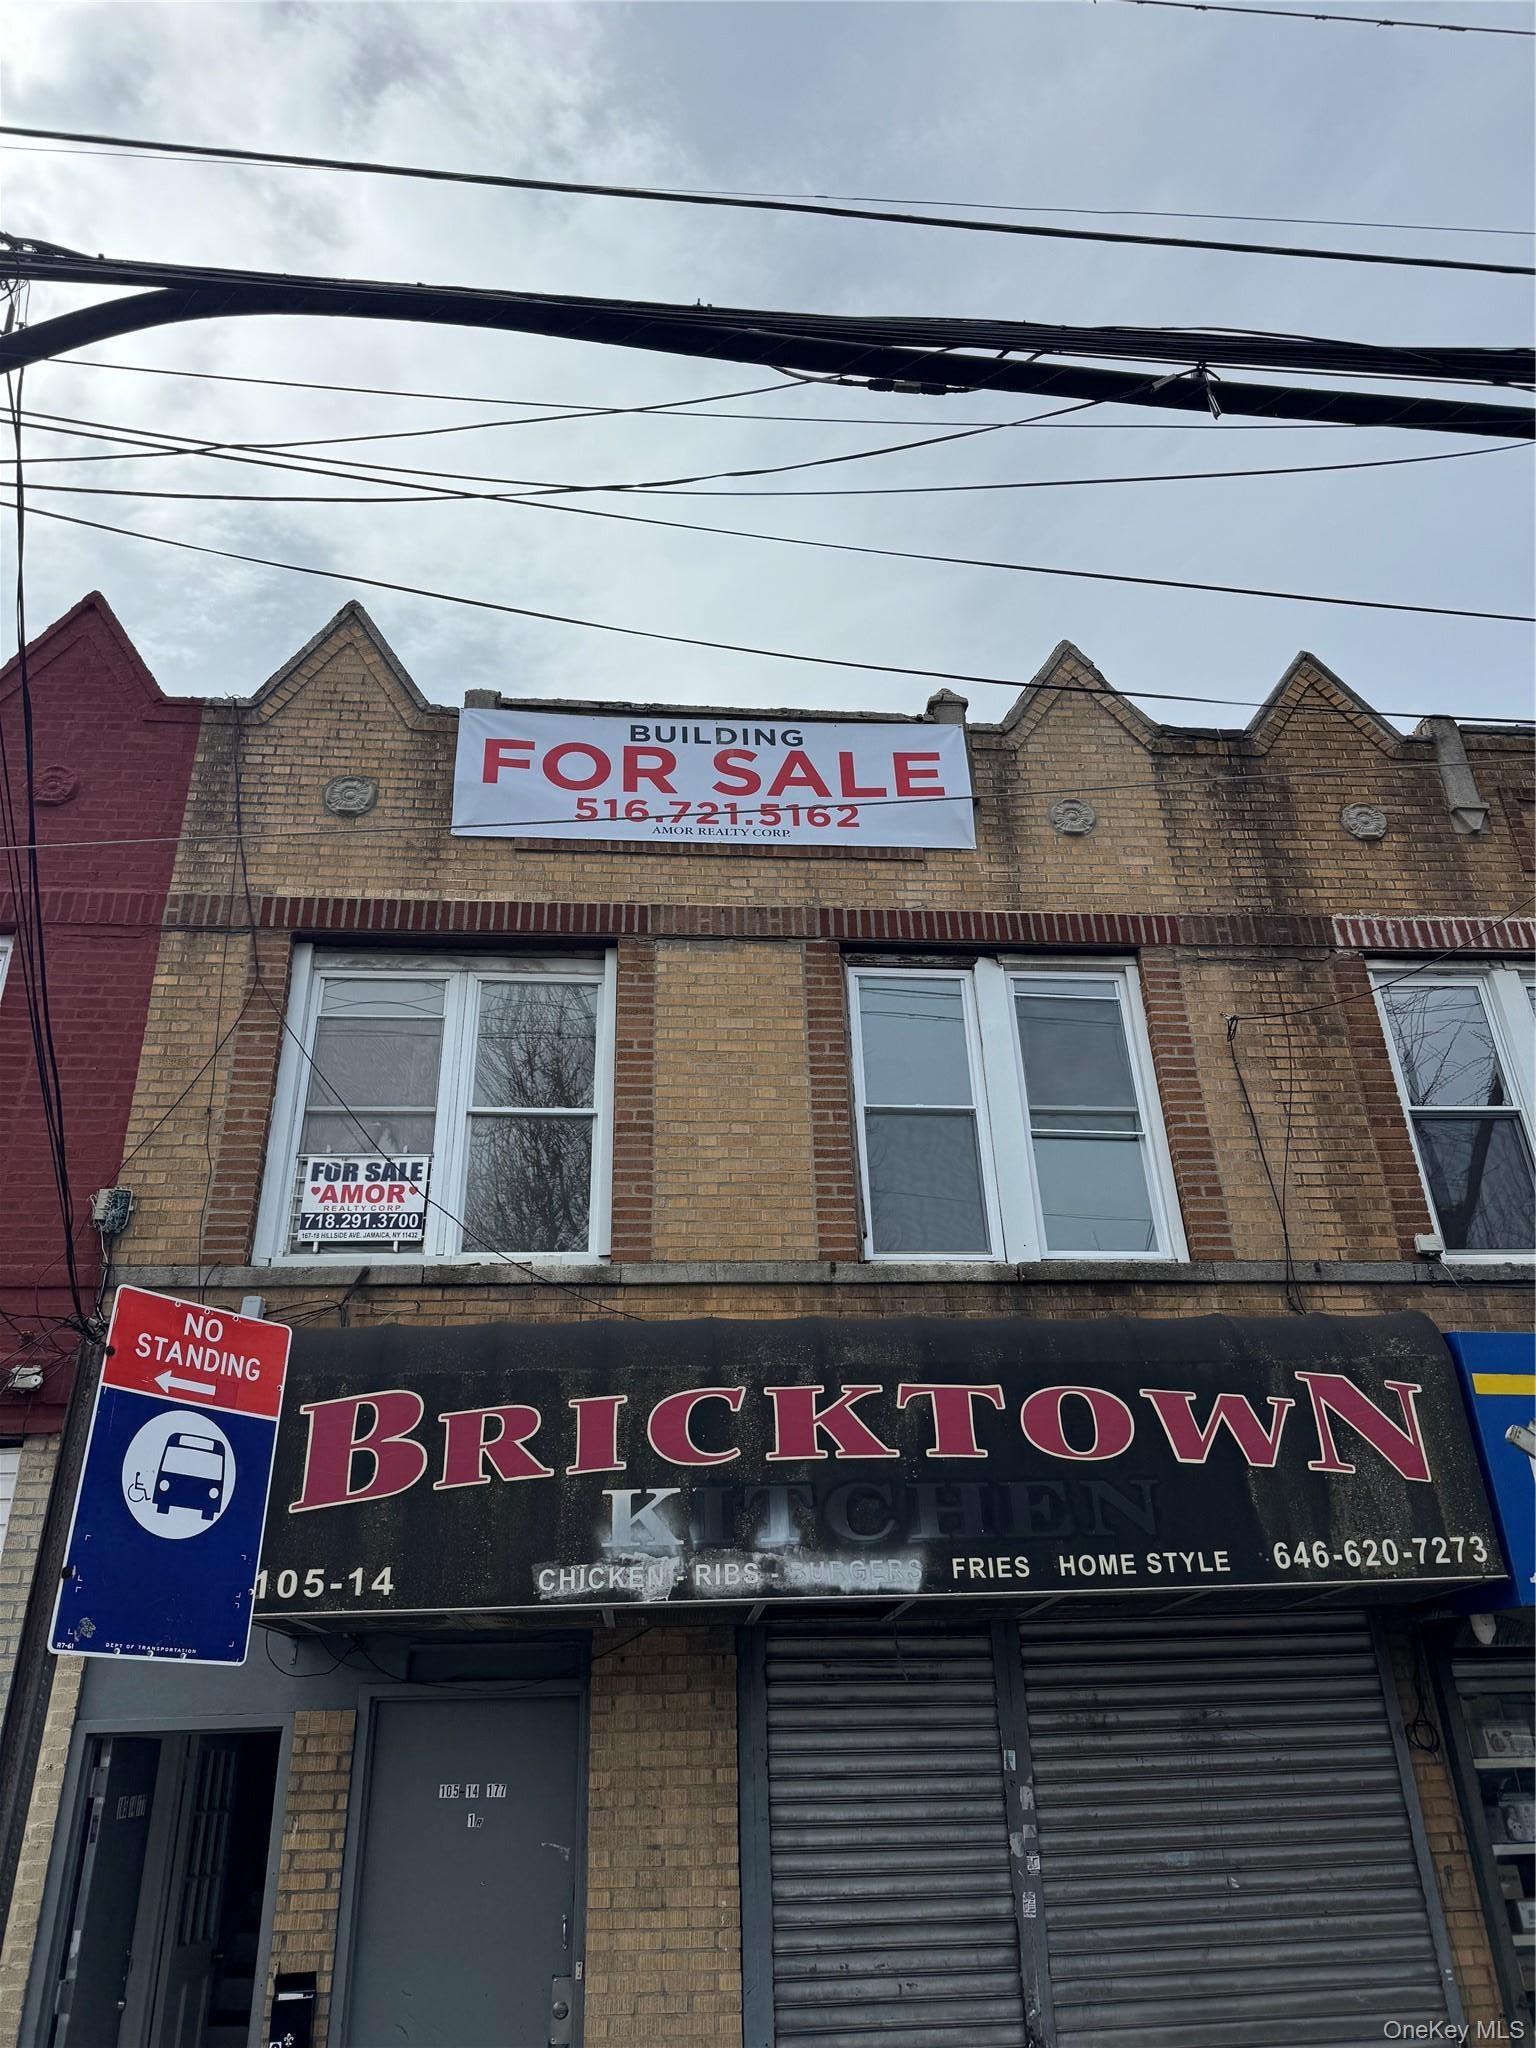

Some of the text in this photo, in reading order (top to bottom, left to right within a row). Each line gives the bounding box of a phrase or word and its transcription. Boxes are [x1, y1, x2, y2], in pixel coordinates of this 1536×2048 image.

[630, 725, 804, 747] BUILDING
[482, 738, 946, 798] FOR SALE
[574, 797, 860, 828] 516.721.5162
[652, 826, 791, 838] AMOR REALTY CORP.
[310, 1162, 424, 1182] FOR SALE
[318, 1184, 406, 1204] AMOR
[304, 1213, 419, 1229] 718.291.3700
[184, 1312, 224, 1343] NO
[135, 1332, 261, 1382] STANDING
[287, 1370, 1432, 1514] BRICKTOWN
[601, 1478, 1162, 1550] KITCHEN
[1273, 1535, 1488, 1569] 646-620-7273
[255, 1566, 394, 1599] 105-14
[538, 1568, 664, 1591] CHICKEN
[694, 1563, 759, 1586] RIBS
[951, 1556, 1030, 1579] FRIES
[1058, 1553, 1136, 1576] HOME
[1146, 1549, 1231, 1574] STYLE
[138, 1645, 197, 1654] TRANSPORTATION
[440, 1783, 506, 1798] 105-14 177
